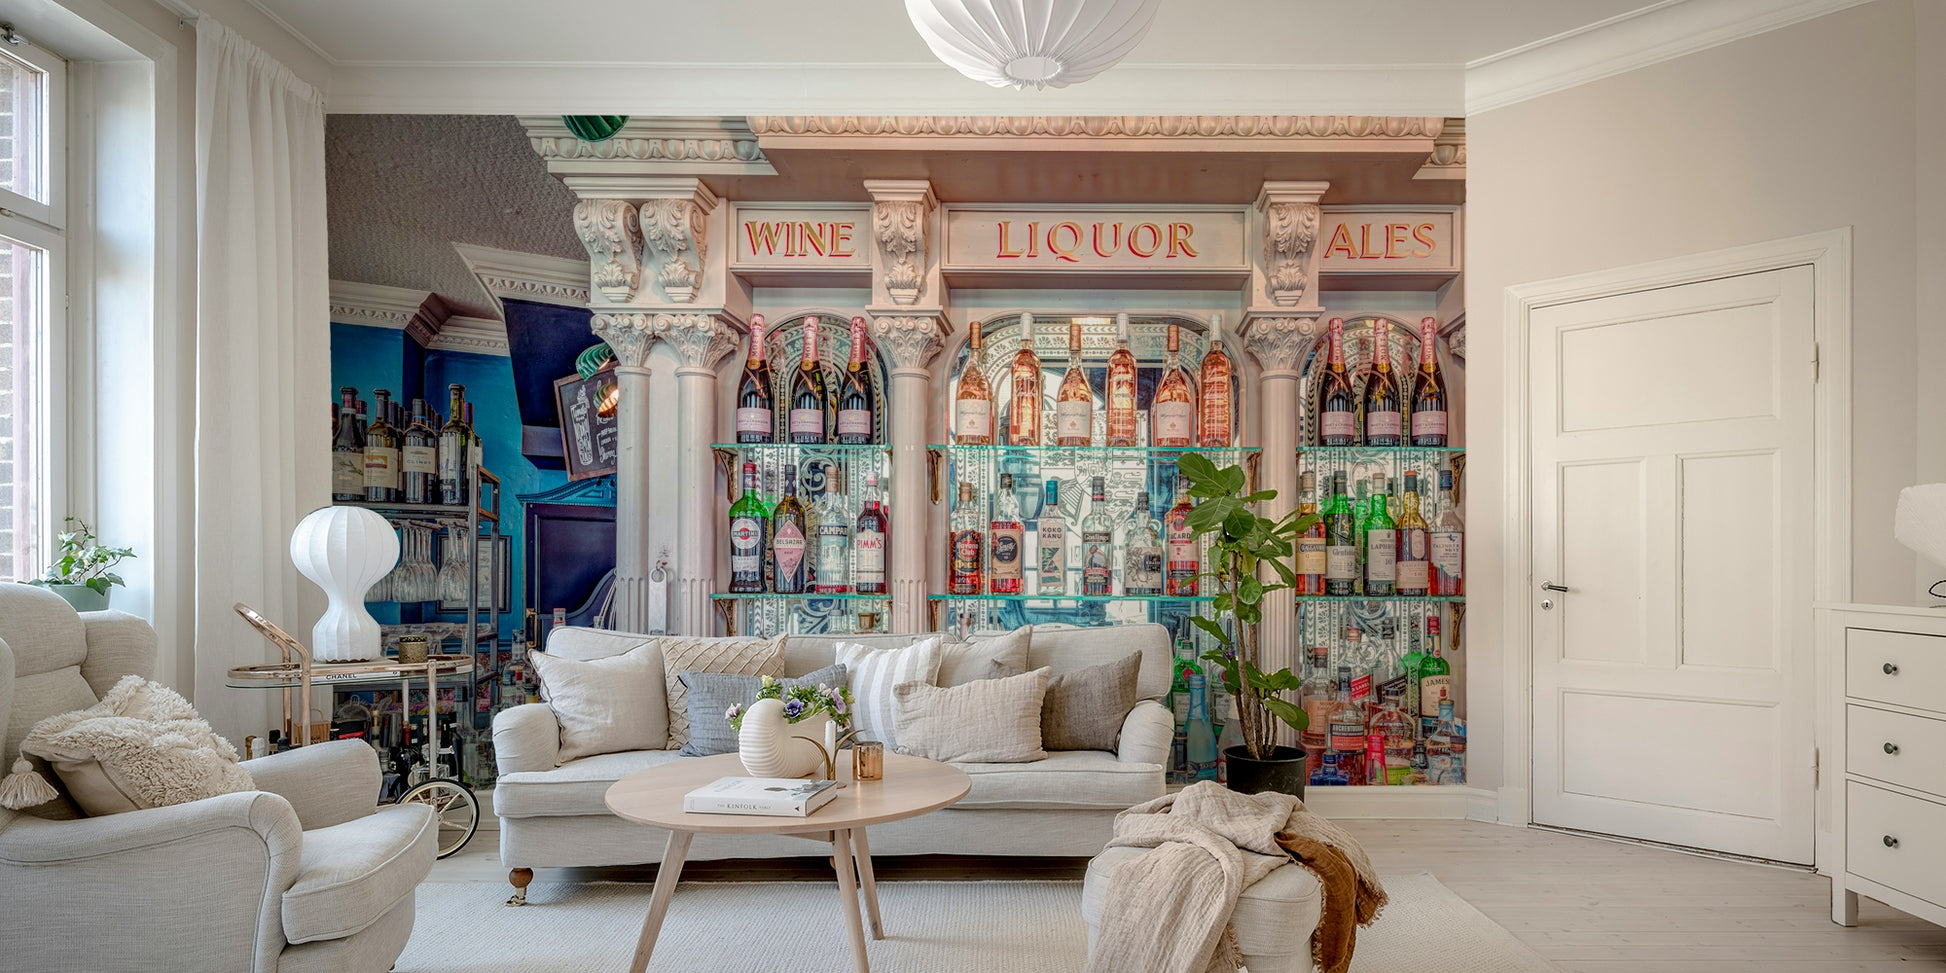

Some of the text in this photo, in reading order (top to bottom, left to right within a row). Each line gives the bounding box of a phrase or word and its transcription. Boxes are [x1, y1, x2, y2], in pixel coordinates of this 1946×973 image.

[744, 220, 857, 258] WINE
[996, 220, 1200, 263] LIQUOR
[1323, 221, 1437, 259] ALES
[326, 672, 358, 680] CHANEL
